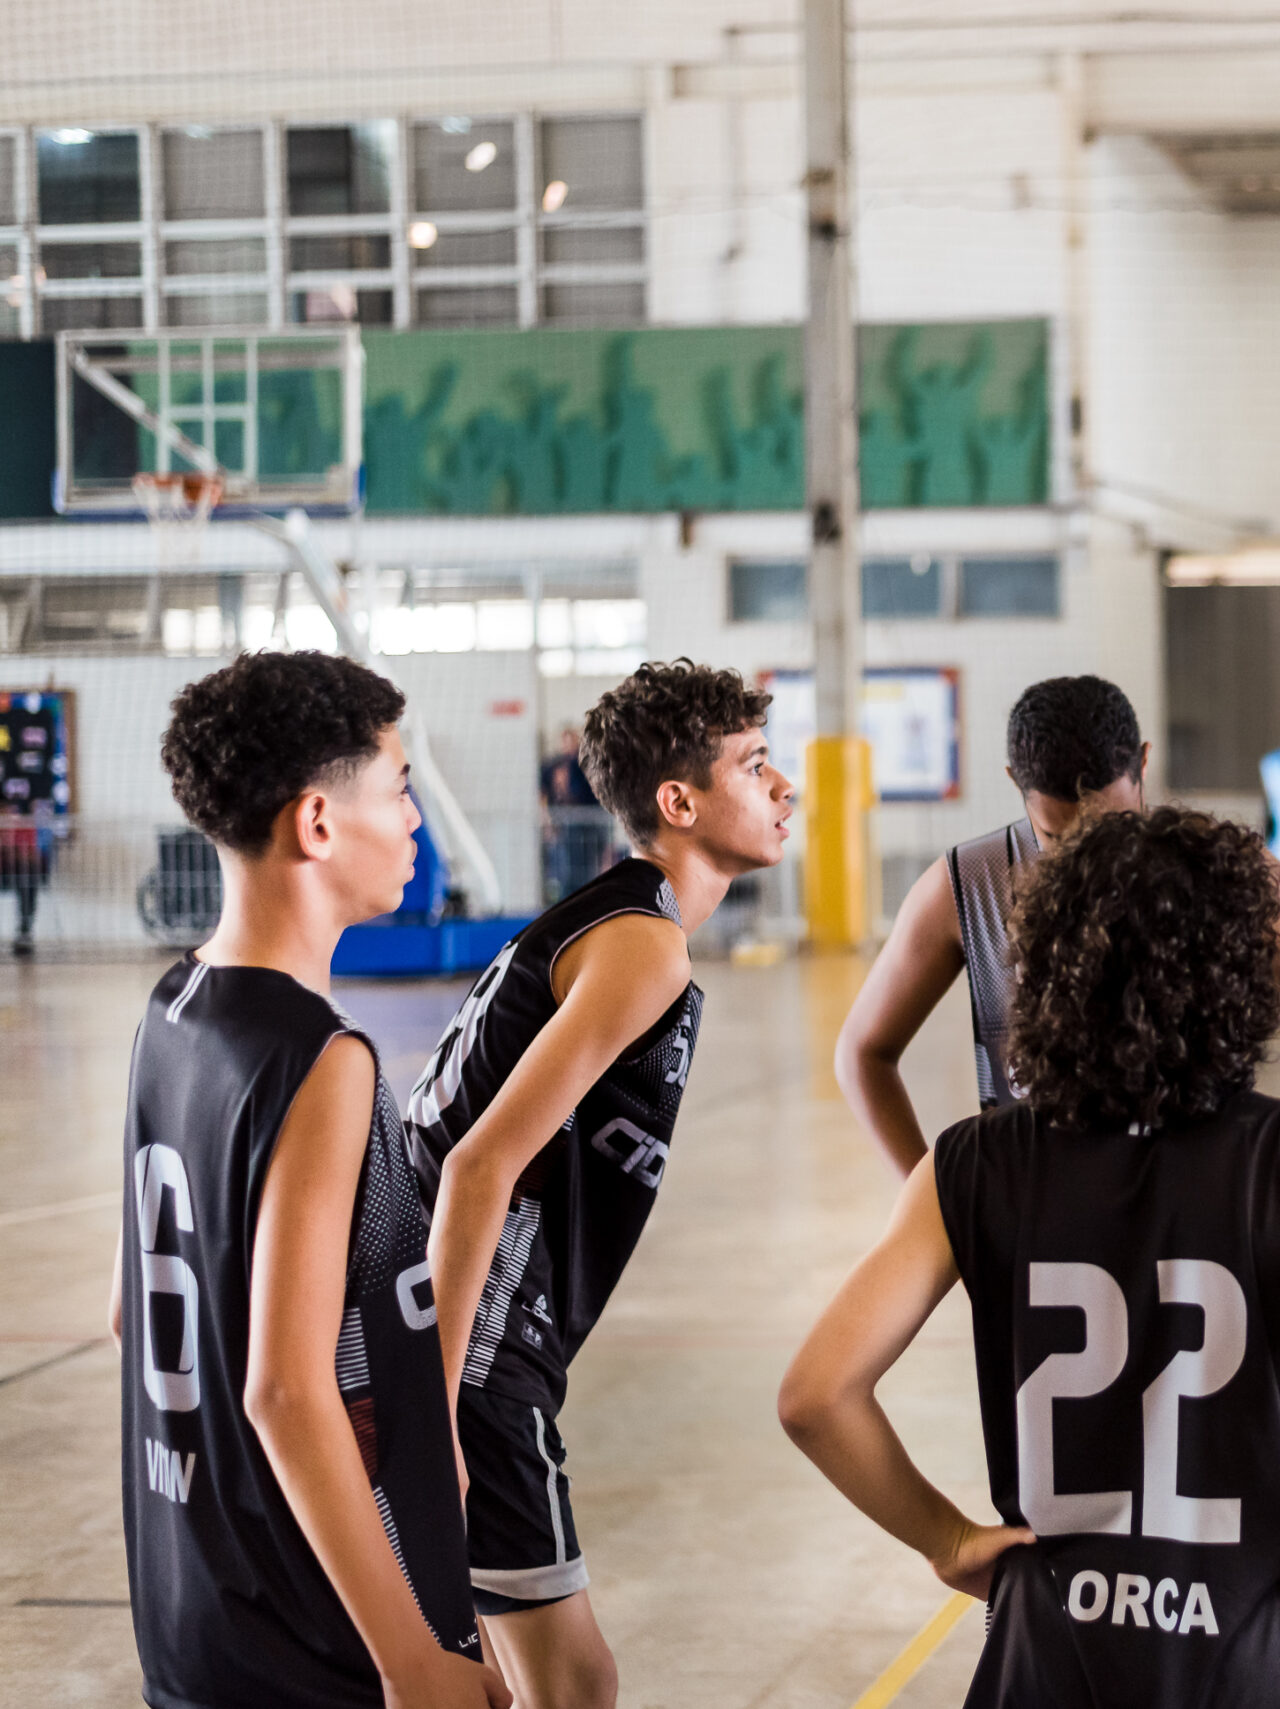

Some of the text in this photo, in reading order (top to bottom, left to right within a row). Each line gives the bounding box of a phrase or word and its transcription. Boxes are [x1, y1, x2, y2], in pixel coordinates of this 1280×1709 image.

[134, 1143, 200, 1412] 6
[1016, 1259, 1248, 1544] 22
[1068, 1570, 1219, 1635] ORCA
